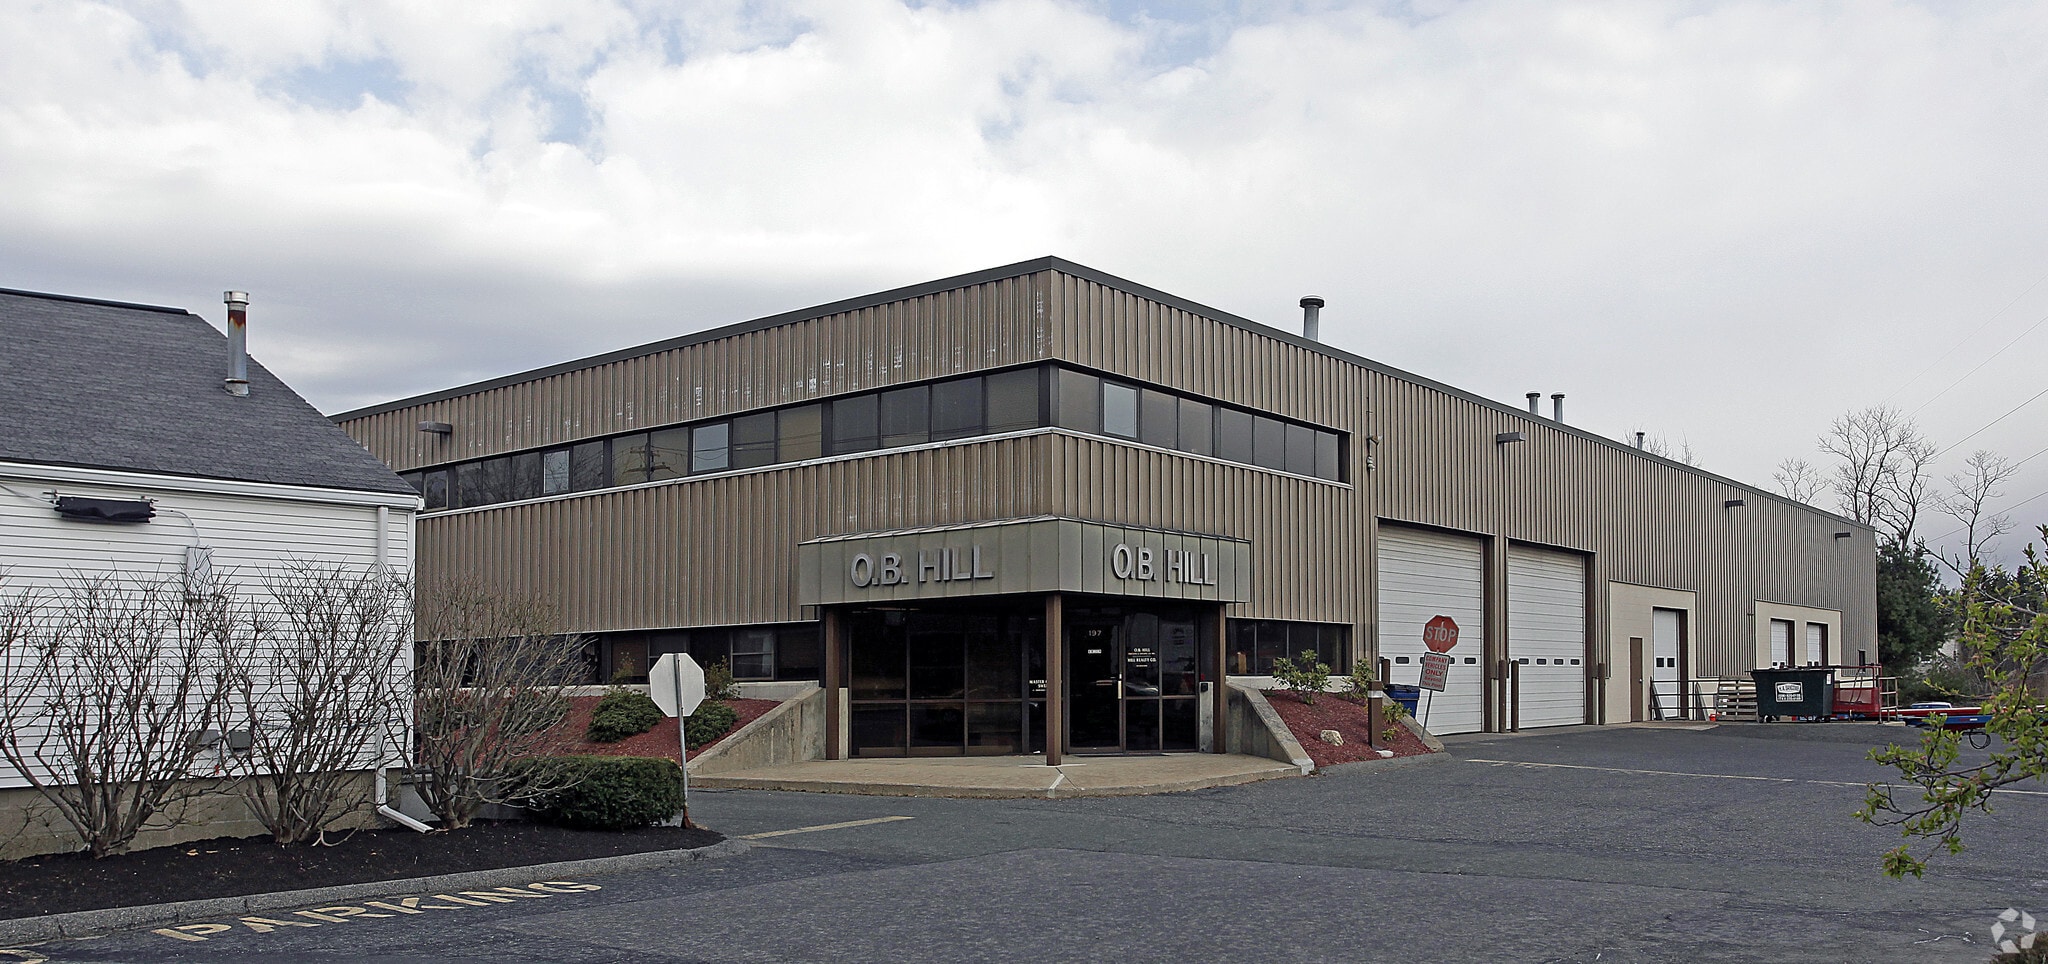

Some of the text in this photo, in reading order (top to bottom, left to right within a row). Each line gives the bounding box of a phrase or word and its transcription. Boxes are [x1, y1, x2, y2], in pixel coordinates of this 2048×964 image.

[851, 545, 995, 588] O.B. HILL
[1110, 543, 1215, 586] O.B. HILL
[1426, 626, 1457, 642] STOP
[1425, 662, 1446, 670] VEHICLES
[1426, 655, 1447, 663] COMPANY
[1425, 669, 1443, 677] ONLY
[151, 880, 602, 941] PARKING
